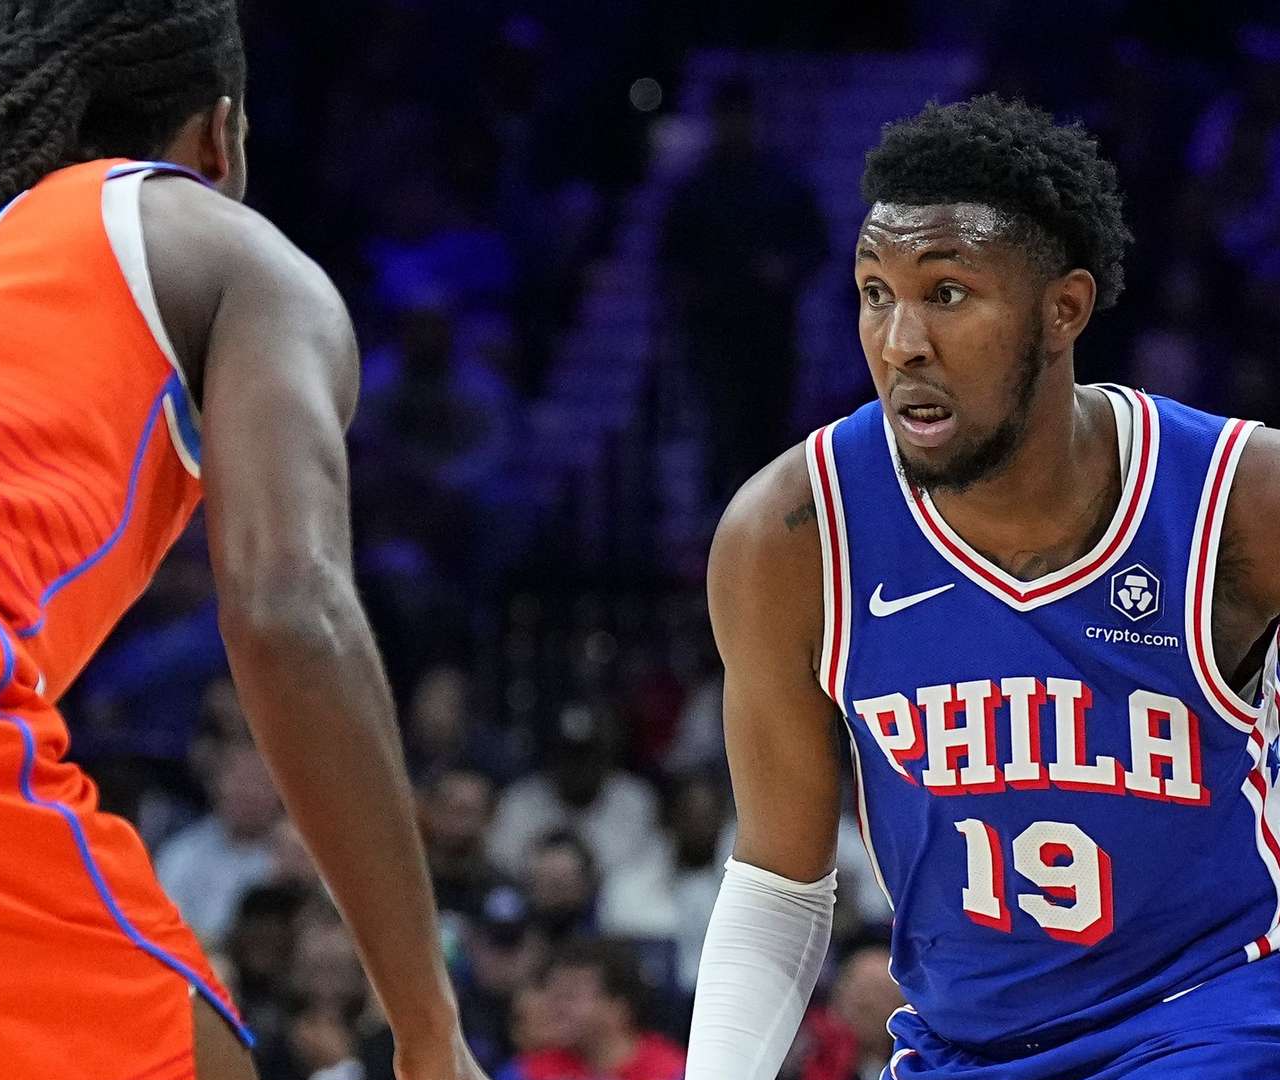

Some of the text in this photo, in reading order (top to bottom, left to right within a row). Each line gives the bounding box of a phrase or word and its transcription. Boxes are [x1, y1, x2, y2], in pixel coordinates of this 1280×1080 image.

[1085, 626, 1179, 647] crypto.com
[853, 677, 1211, 805] PHILA
[954, 818, 1114, 946] 19
